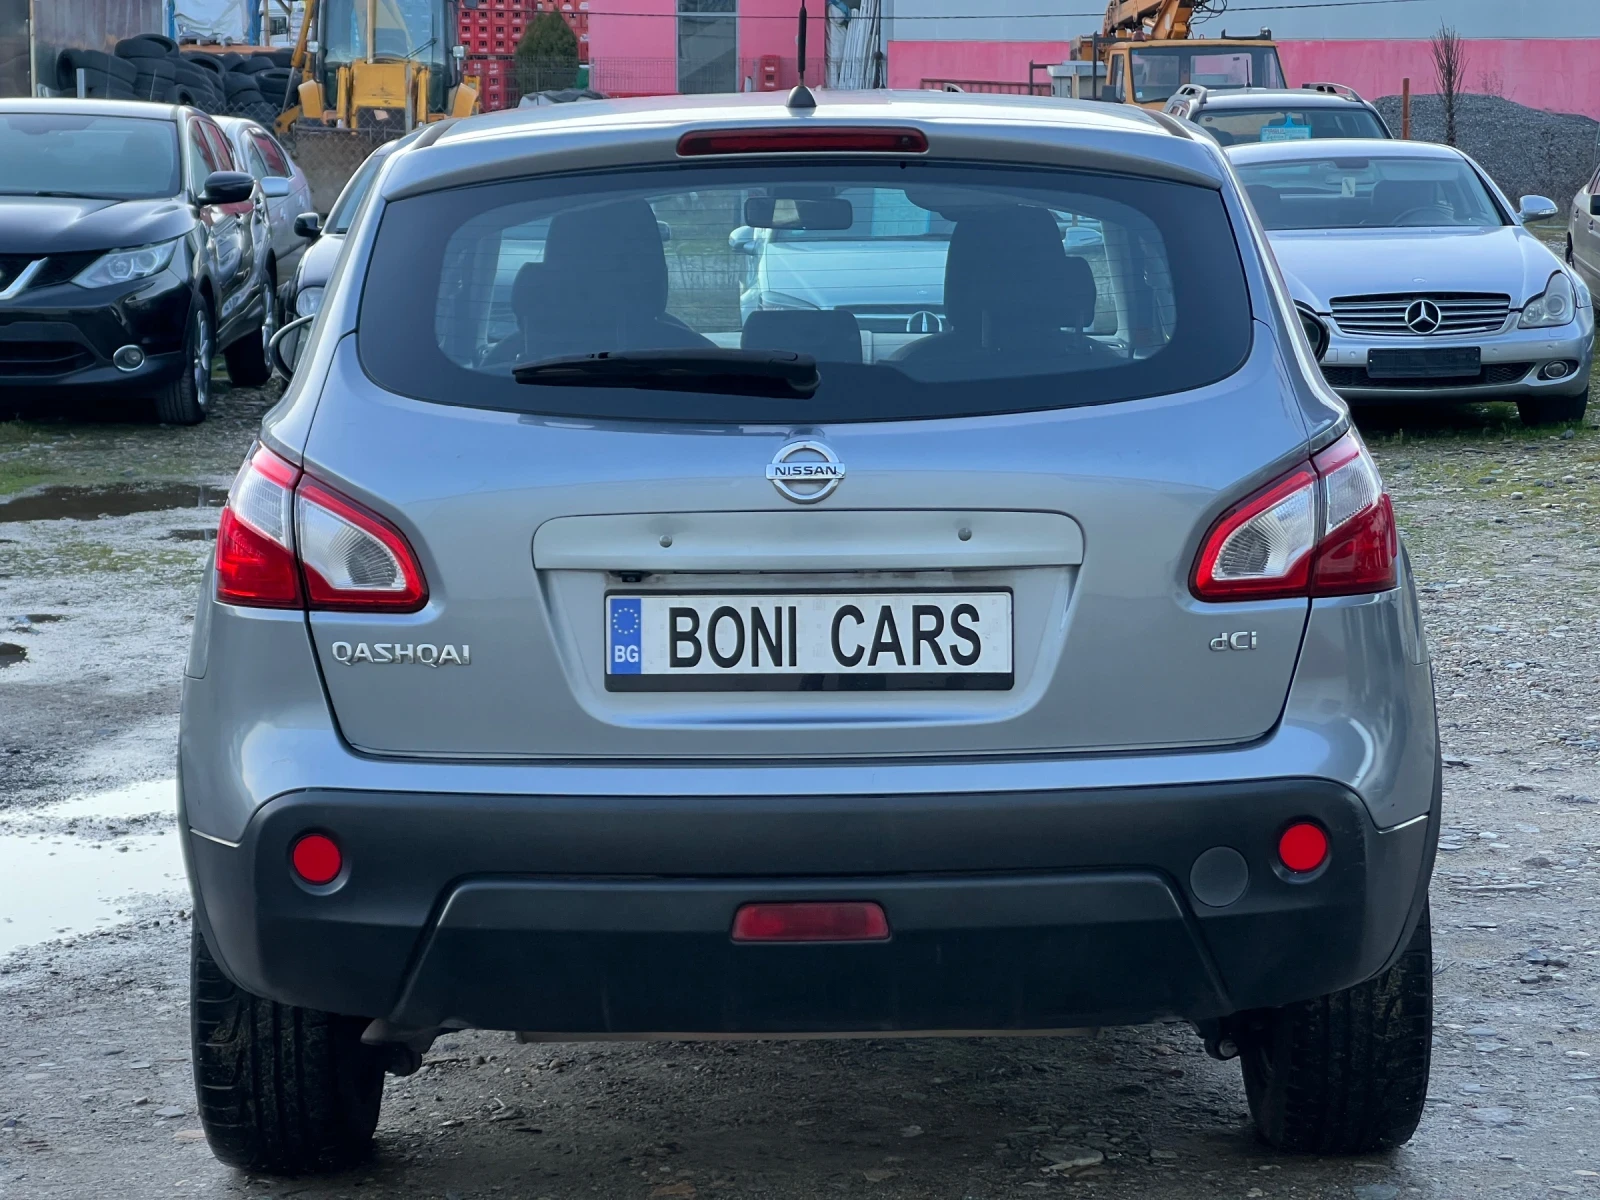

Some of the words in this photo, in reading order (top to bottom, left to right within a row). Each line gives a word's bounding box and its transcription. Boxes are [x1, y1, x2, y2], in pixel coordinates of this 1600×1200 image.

[775, 465, 837, 476] NISSAN
[668, 605, 798, 668] BONI
[830, 603, 982, 668] CARS
[1209, 631, 1257, 651] dCi
[331, 641, 471, 668] QASHQAI
[614, 645, 639, 663] BG
